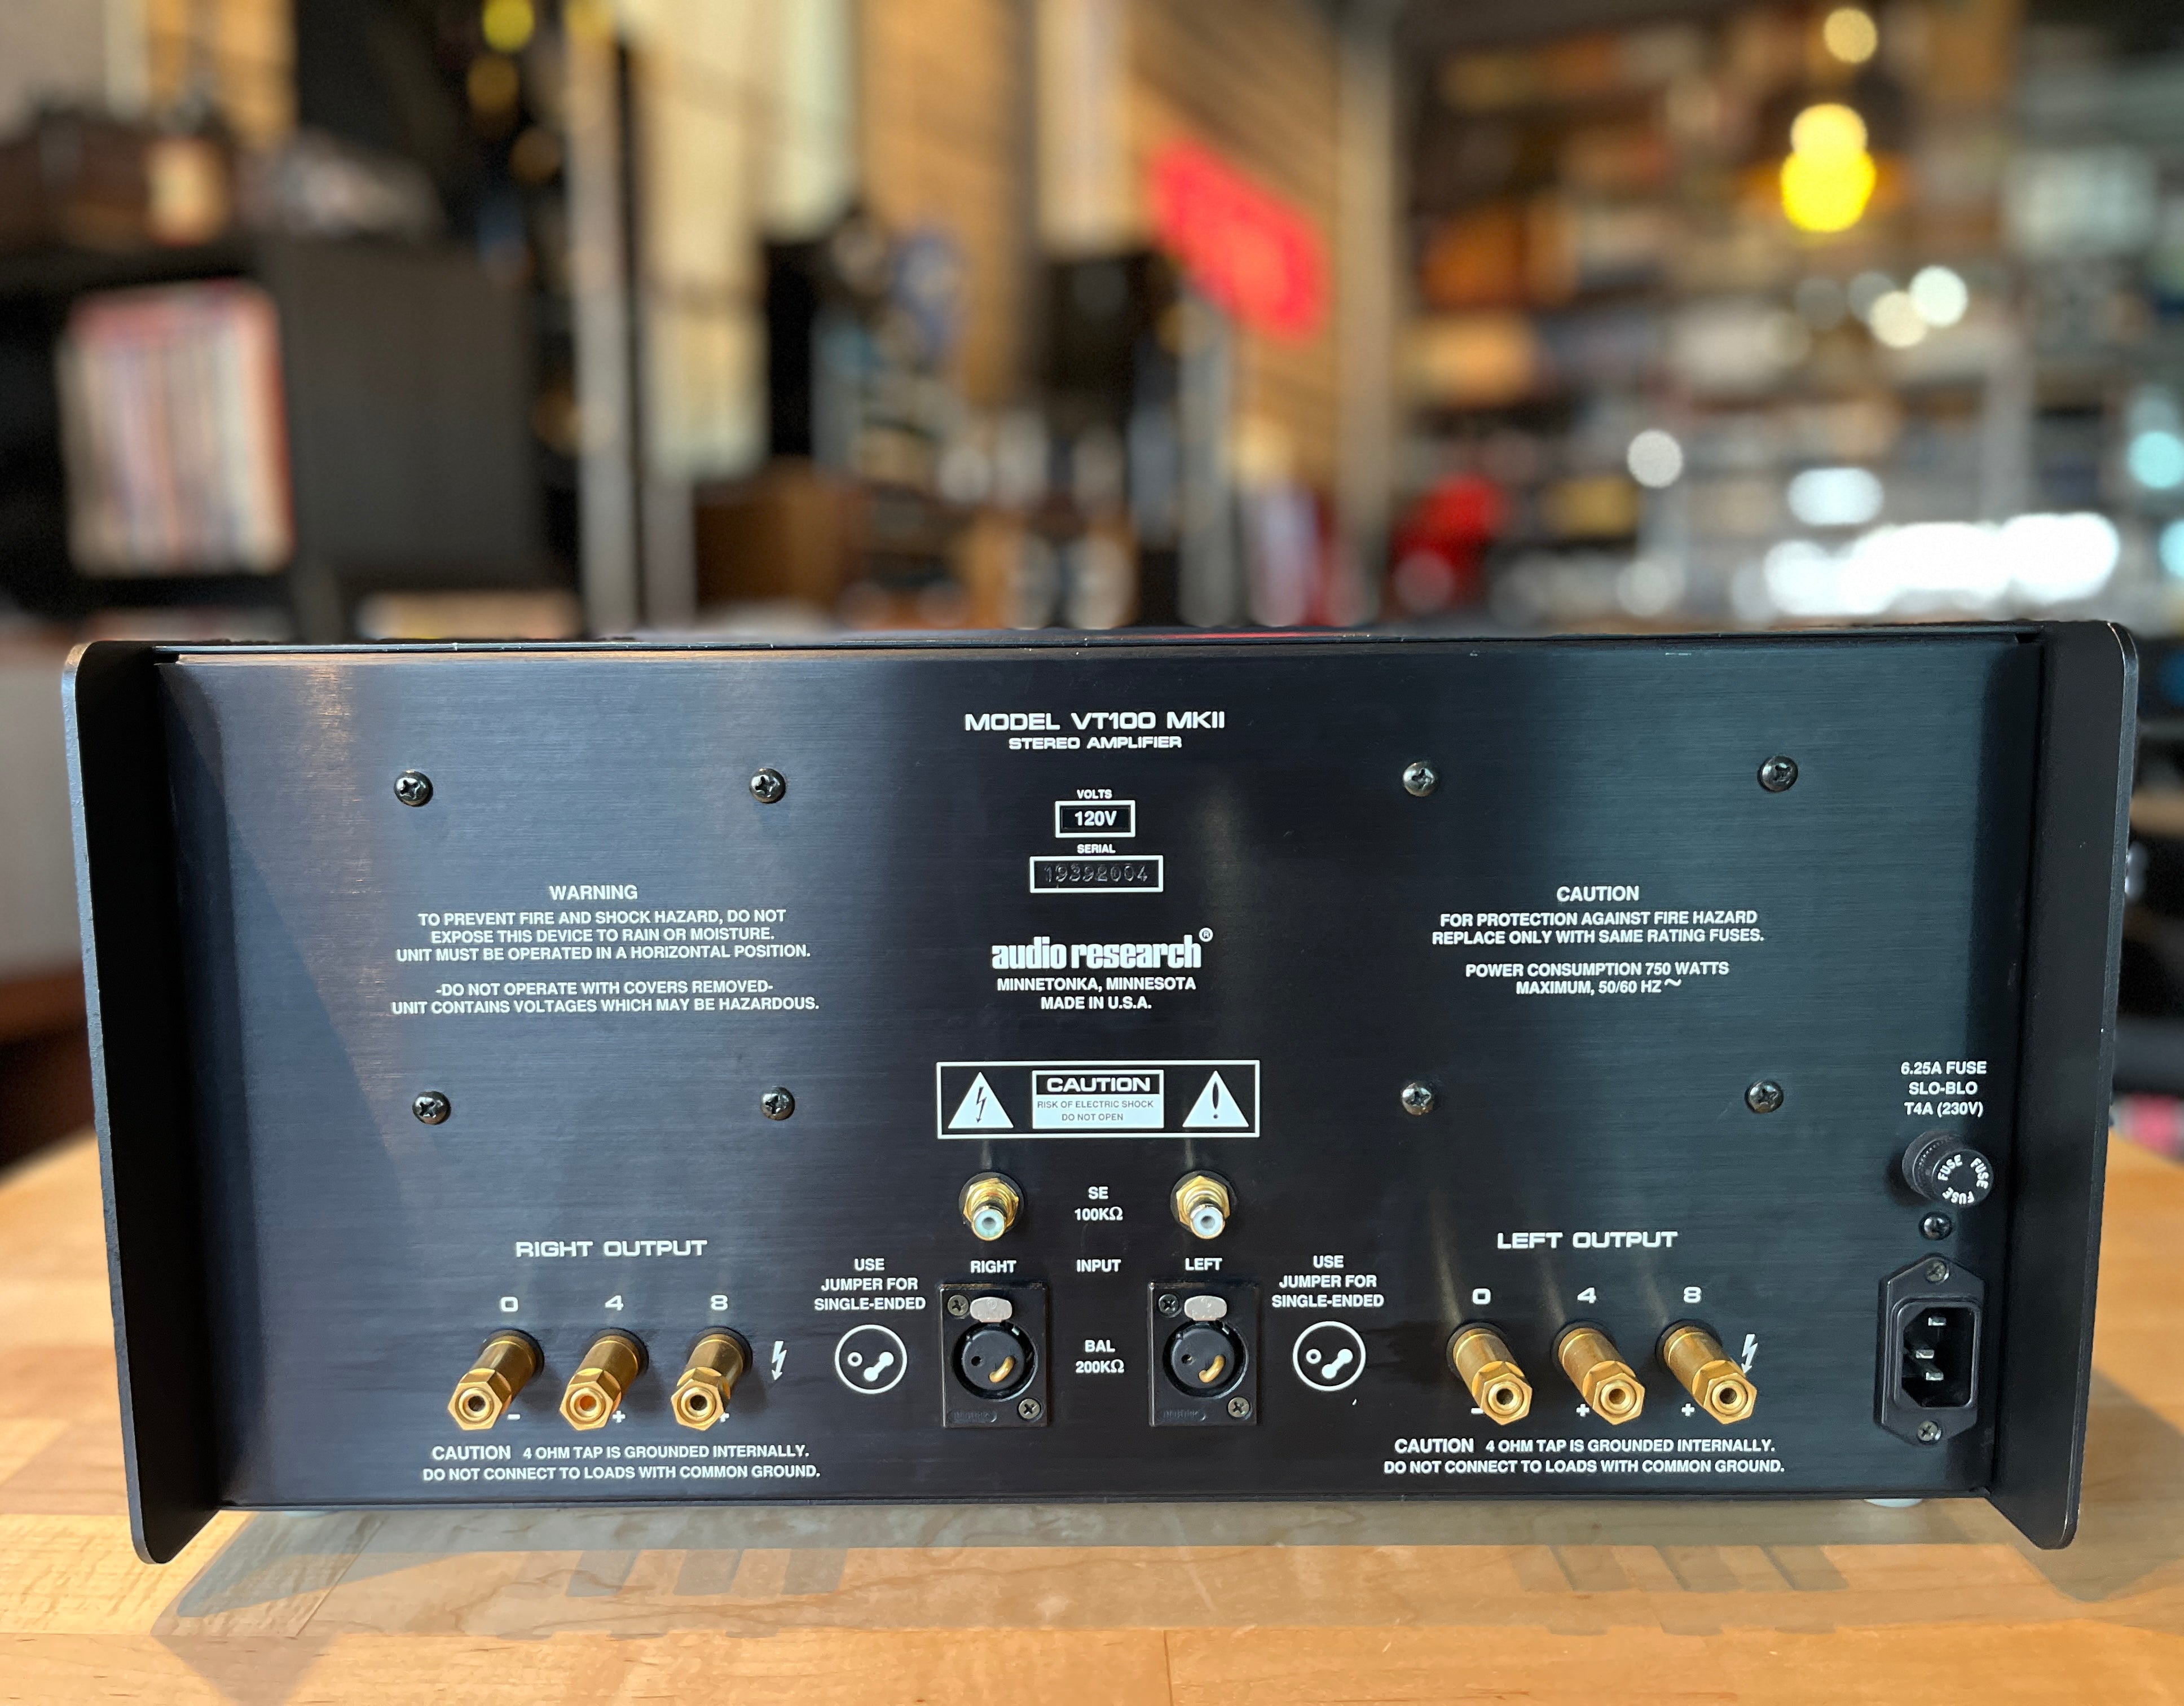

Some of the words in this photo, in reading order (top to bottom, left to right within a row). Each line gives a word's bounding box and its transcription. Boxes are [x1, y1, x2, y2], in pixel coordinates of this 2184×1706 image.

[965, 713, 1060, 731] MODEL
[1071, 711, 1156, 729] VT100
[1166, 711, 1224, 729] MKII
[1009, 736, 1080, 749] STEREO
[1086, 736, 1182, 749] AMPLIFIER
[1076, 789, 1112, 799] VOLTS
[1075, 810, 1117, 826] 120V
[1077, 843, 1116, 854] SERIAL
[549, 884, 637, 900] WARNING
[1556, 885, 1639, 902] CAUTION
[417, 912, 440, 926] TO
[443, 912, 516, 926] PREVENT
[519, 911, 554, 925] FIRE
[558, 911, 591, 925] AND
[595, 910, 650, 924] SHOCK
[654, 909, 723, 925] HAZARD,
[727, 909, 750, 923] DO
[754, 909, 786, 922] NOT
[1440, 913, 1473, 927] FOR
[1477, 912, 1577, 927] PROTECTION
[1580, 911, 1650, 926] AGAINST
[1654, 911, 1689, 924] FIRE
[1692, 910, 1758, 925] HAZARD
[430, 929, 494, 944] EXPOSE
[496, 929, 532, 943] THIS
[536, 929, 593, 943] DEVICE
[596, 928, 618, 942] TO
[622, 928, 659, 941] RAIN
[663, 927, 686, 941] OR
[690, 927, 774, 941] MOISTURE.
[1432, 930, 1505, 944] REPLACE
[1509, 930, 1552, 944] ONLY
[1555, 929, 1595, 944] WITH
[1598, 929, 1643, 943] SAME
[1647, 928, 1705, 943] RATING
[1709, 927, 1764, 942] FUSES.
[395, 948, 432, 962] UNIT
[435, 947, 479, 961] MUST
[483, 947, 504, 961] BE
[507, 946, 592, 960] OPERATED
[596, 946, 611, 960] IN
[615, 946, 627, 959] A
[630, 944, 730, 959] HORIZONTAL
[734, 944, 810, 958] POSITION.
[992, 936, 1067, 969] audio
[1465, 962, 1523, 977] POWER
[1527, 961, 1641, 977] CONSUMPTION
[1645, 962, 1671, 975] 750
[1674, 961, 1729, 975] WATTS
[435, 983, 464, 996] -DO
[468, 982, 500, 996] NOT
[503, 982, 577, 996] OPERATE
[580, 981, 619, 995] WITH
[623, 980, 688, 994] COVERS
[692, 979, 773, 993] REMOVED-
[997, 977, 1102, 992] MINNETONKA,
[1106, 976, 1196, 990] MINNESOTA
[1516, 980, 1595, 996] MAXIMUM,
[1598, 979, 1637, 994] 50/60
[1640, 979, 1662, 993] HZ
[391, 1001, 428, 1014] UNIT
[430, 1000, 510, 1014] CONTAINS
[513, 999, 597, 1013] VOLTAGES
[600, 998, 652, 1012] WHICH
[656, 997, 689, 1011] MAY
[694, 997, 715, 1010] BE
[719, 996, 819, 1010] HAZARDOUS.
[1041, 996, 1085, 1009] MADE
[1089, 996, 1103, 1009] IN
[1108, 996, 1151, 1009] U.S.A.
[1901, 1061, 1942, 1075] 6.25A
[1946, 1061, 1987, 1075] FUSE
[1046, 1077, 1150, 1092] CAUTION
[1908, 1081, 1978, 1095] SLO-BLO
[1904, 1101, 1933, 1115] T4A
[1936, 1101, 1983, 1118] (230V)
[1938, 1154, 1963, 1181] FUSE
[1970, 1158, 1989, 1189] FUSE
[1088, 1186, 1108, 1199] SE
[1942, 1186, 1975, 1204] FUSE
[1074, 1206, 1122, 1221] 100KΩ
[515, 1241, 593, 1257] RIGHT
[603, 1239, 707, 1257] OUTPUT
[1497, 1232, 1563, 1249] LEFT
[1572, 1231, 1678, 1248] OUTPUT
[854, 1257, 884, 1271] USE
[970, 1260, 1016, 1273] RIGHT
[1076, 1259, 1121, 1272] INPUT
[1185, 1257, 1222, 1270] LEFT
[1313, 1255, 1344, 1268] USE
[821, 1277, 882, 1291] JUMPER
[886, 1277, 918, 1291] FOR
[1279, 1274, 1341, 1288] JUMPER
[1345, 1274, 1376, 1288] FOR
[710, 1294, 728, 1311] 8
[1271, 1294, 1384, 1308] SINGLE-ENDED
[1472, 1287, 1491, 1304] 0
[1577, 1287, 1596, 1304] 4
[1683, 1286, 1701, 1303] 8
[500, 1296, 518, 1312] 0
[605, 1295, 623, 1311] 4
[814, 1296, 926, 1311] SINGLE-ENDED
[1085, 1339, 1115, 1352] BAL
[1075, 1358, 1124, 1374] 200KΩ
[430, 1445, 511, 1461] CAUTION
[522, 1446, 532, 1459] 4
[534, 1446, 570, 1459] OHM
[573, 1446, 603, 1459] TAP
[606, 1445, 620, 1459] IS
[623, 1445, 709, 1458] GROUNDED
[712, 1444, 809, 1458] INTERNALLY.
[1394, 1437, 1473, 1453] CAUTION
[1485, 1440, 1495, 1452] 4
[1498, 1439, 1533, 1453] OHM
[1536, 1439, 1566, 1452] TAP
[1570, 1439, 1584, 1453] IS
[1587, 1439, 1674, 1452] GROUNDED
[1677, 1439, 1774, 1452] INTERNALLY.
[422, 1467, 446, 1481] DO
[448, 1467, 480, 1481] NOT
[483, 1466, 556, 1480] CONNECT
[558, 1466, 580, 1480] TO
[583, 1465, 635, 1479] LOADS
[638, 1465, 676, 1479] WITH
[679, 1465, 747, 1479] COMMON
[751, 1465, 820, 1478] GROUND.
[1384, 1460, 1406, 1474] DO
[1410, 1460, 1442, 1474] NOT
[1444, 1459, 1517, 1474] CONNECT
[1520, 1459, 1542, 1473] TO
[1545, 1459, 1597, 1473] LOADS
[1600, 1459, 1638, 1472] WITH
[1641, 1459, 1711, 1473] COMMON
[1714, 1459, 1784, 1473] GROUND.
